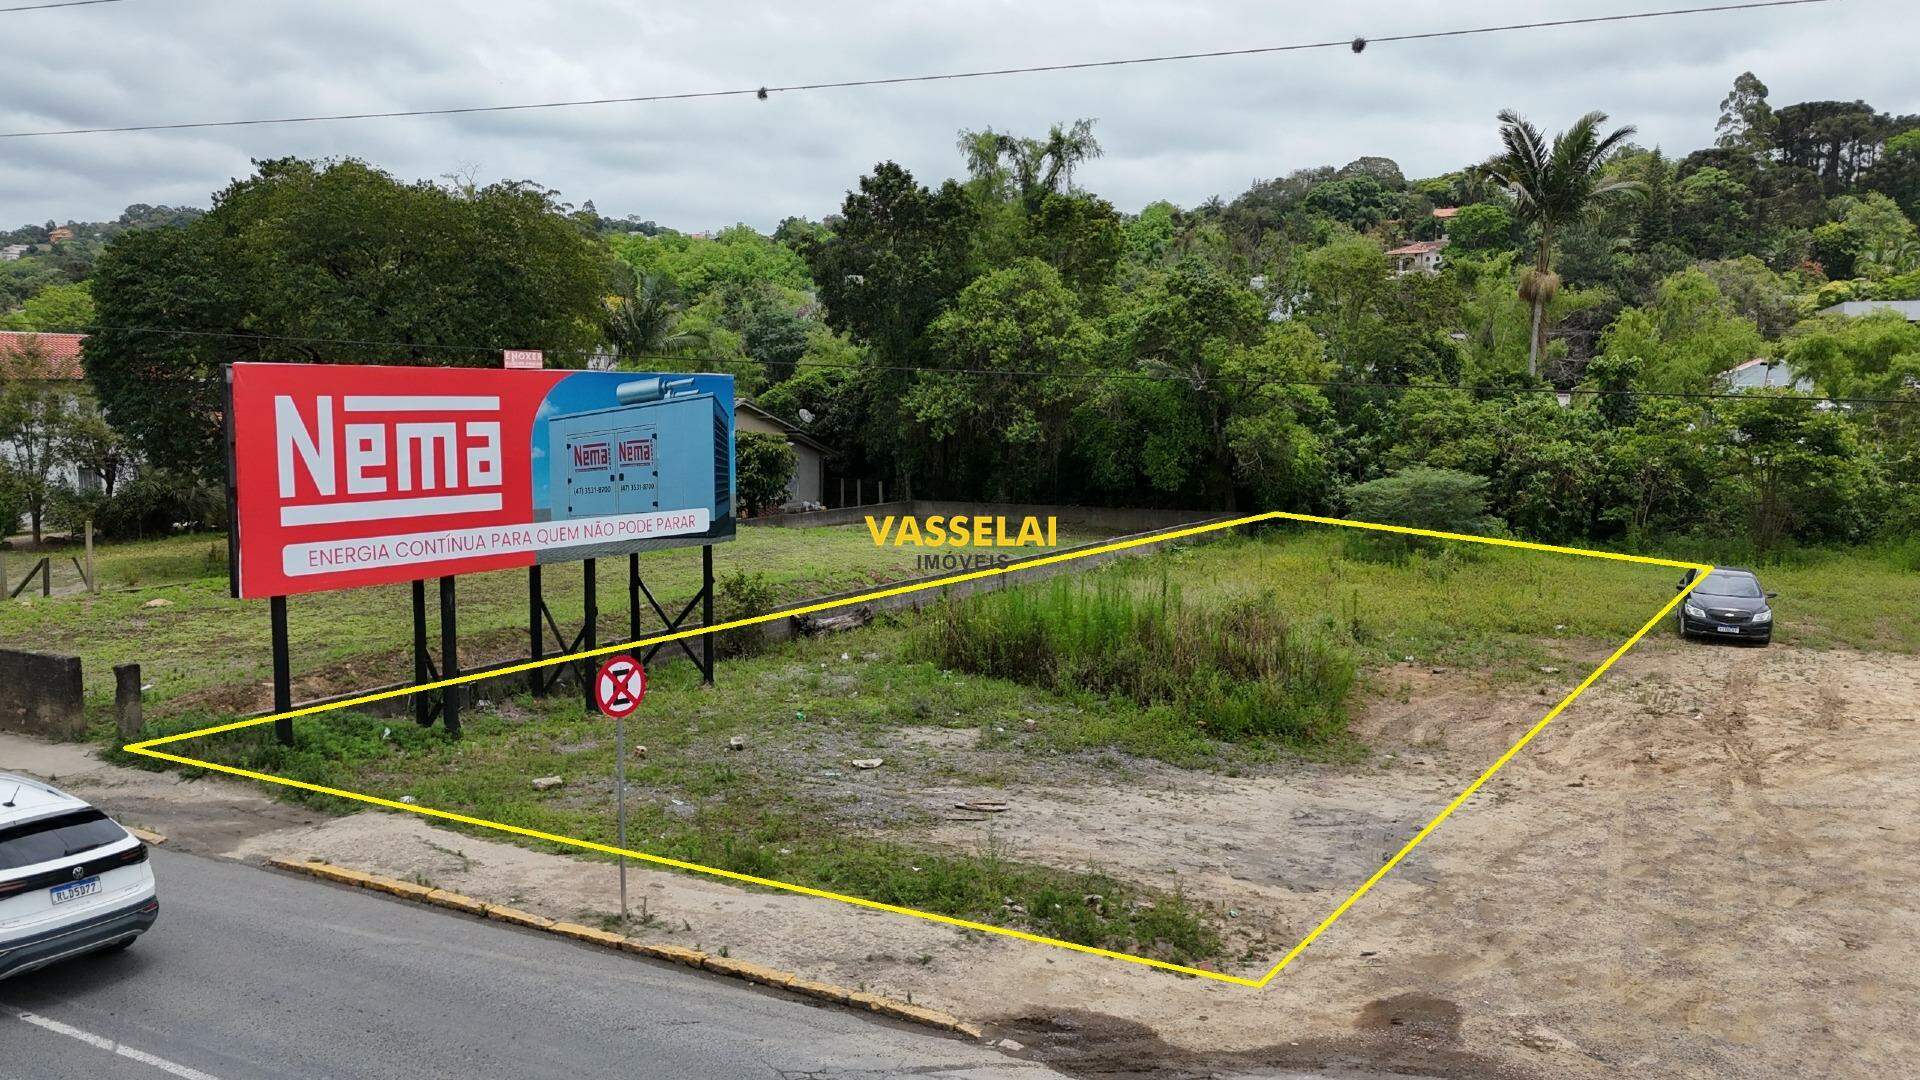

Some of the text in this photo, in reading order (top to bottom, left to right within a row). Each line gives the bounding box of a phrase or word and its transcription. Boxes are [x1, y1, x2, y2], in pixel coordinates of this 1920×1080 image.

[275, 395, 502, 498] Nema
[574, 445, 608, 467] Nema
[619, 441, 650, 462] Nema
[308, 513, 696, 568] ENERGIA CONTÍNUA PARA QUEM NÃO PODE PARAR
